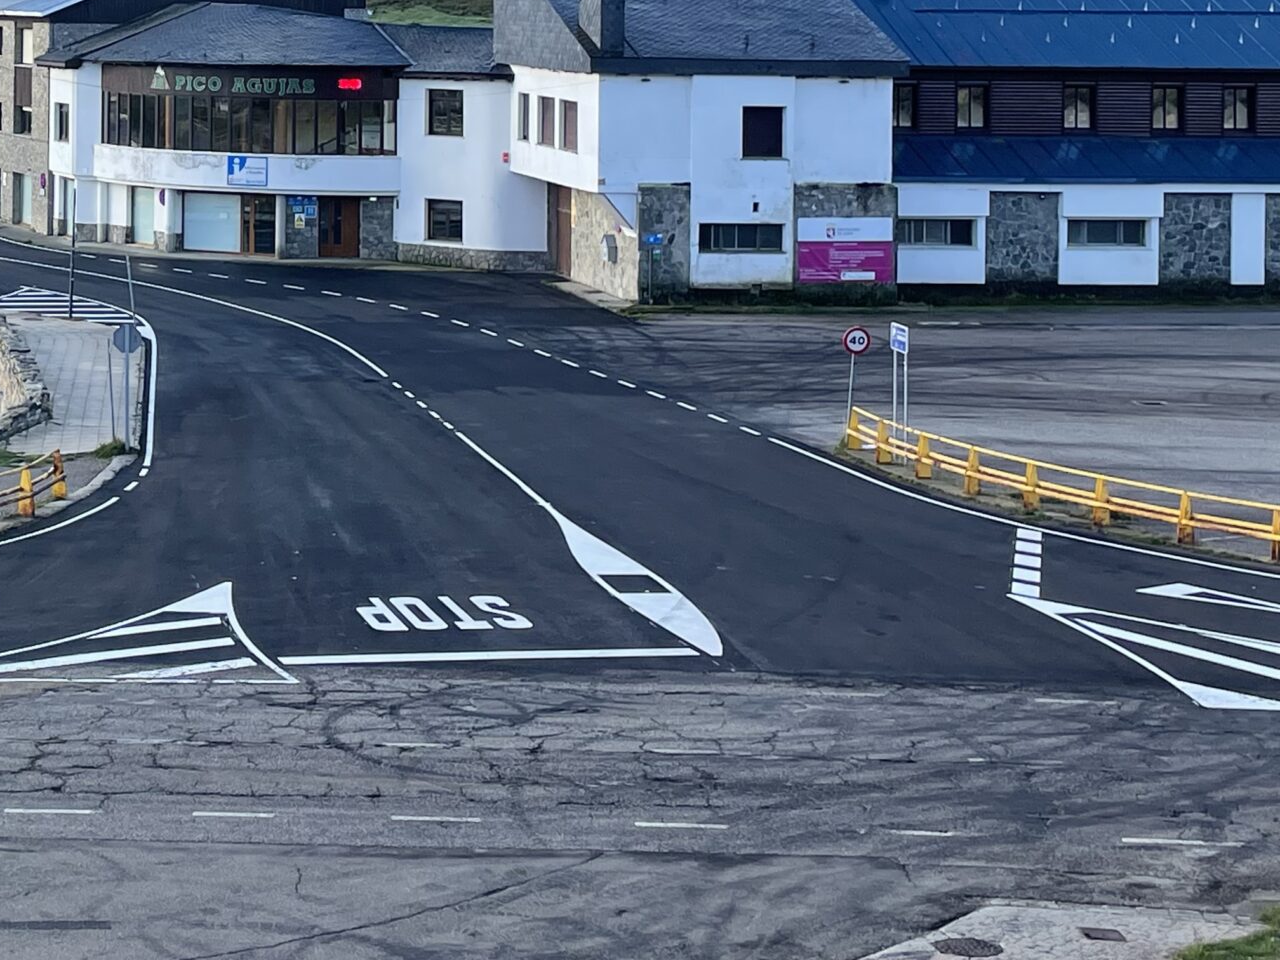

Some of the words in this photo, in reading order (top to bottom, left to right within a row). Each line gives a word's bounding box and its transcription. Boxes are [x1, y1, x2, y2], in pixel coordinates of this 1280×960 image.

[175, 75, 223, 92] PICO
[231, 77, 316, 96] AGUJAS
[848, 336, 866, 345] 40
[355, 595, 534, 632] STOP
